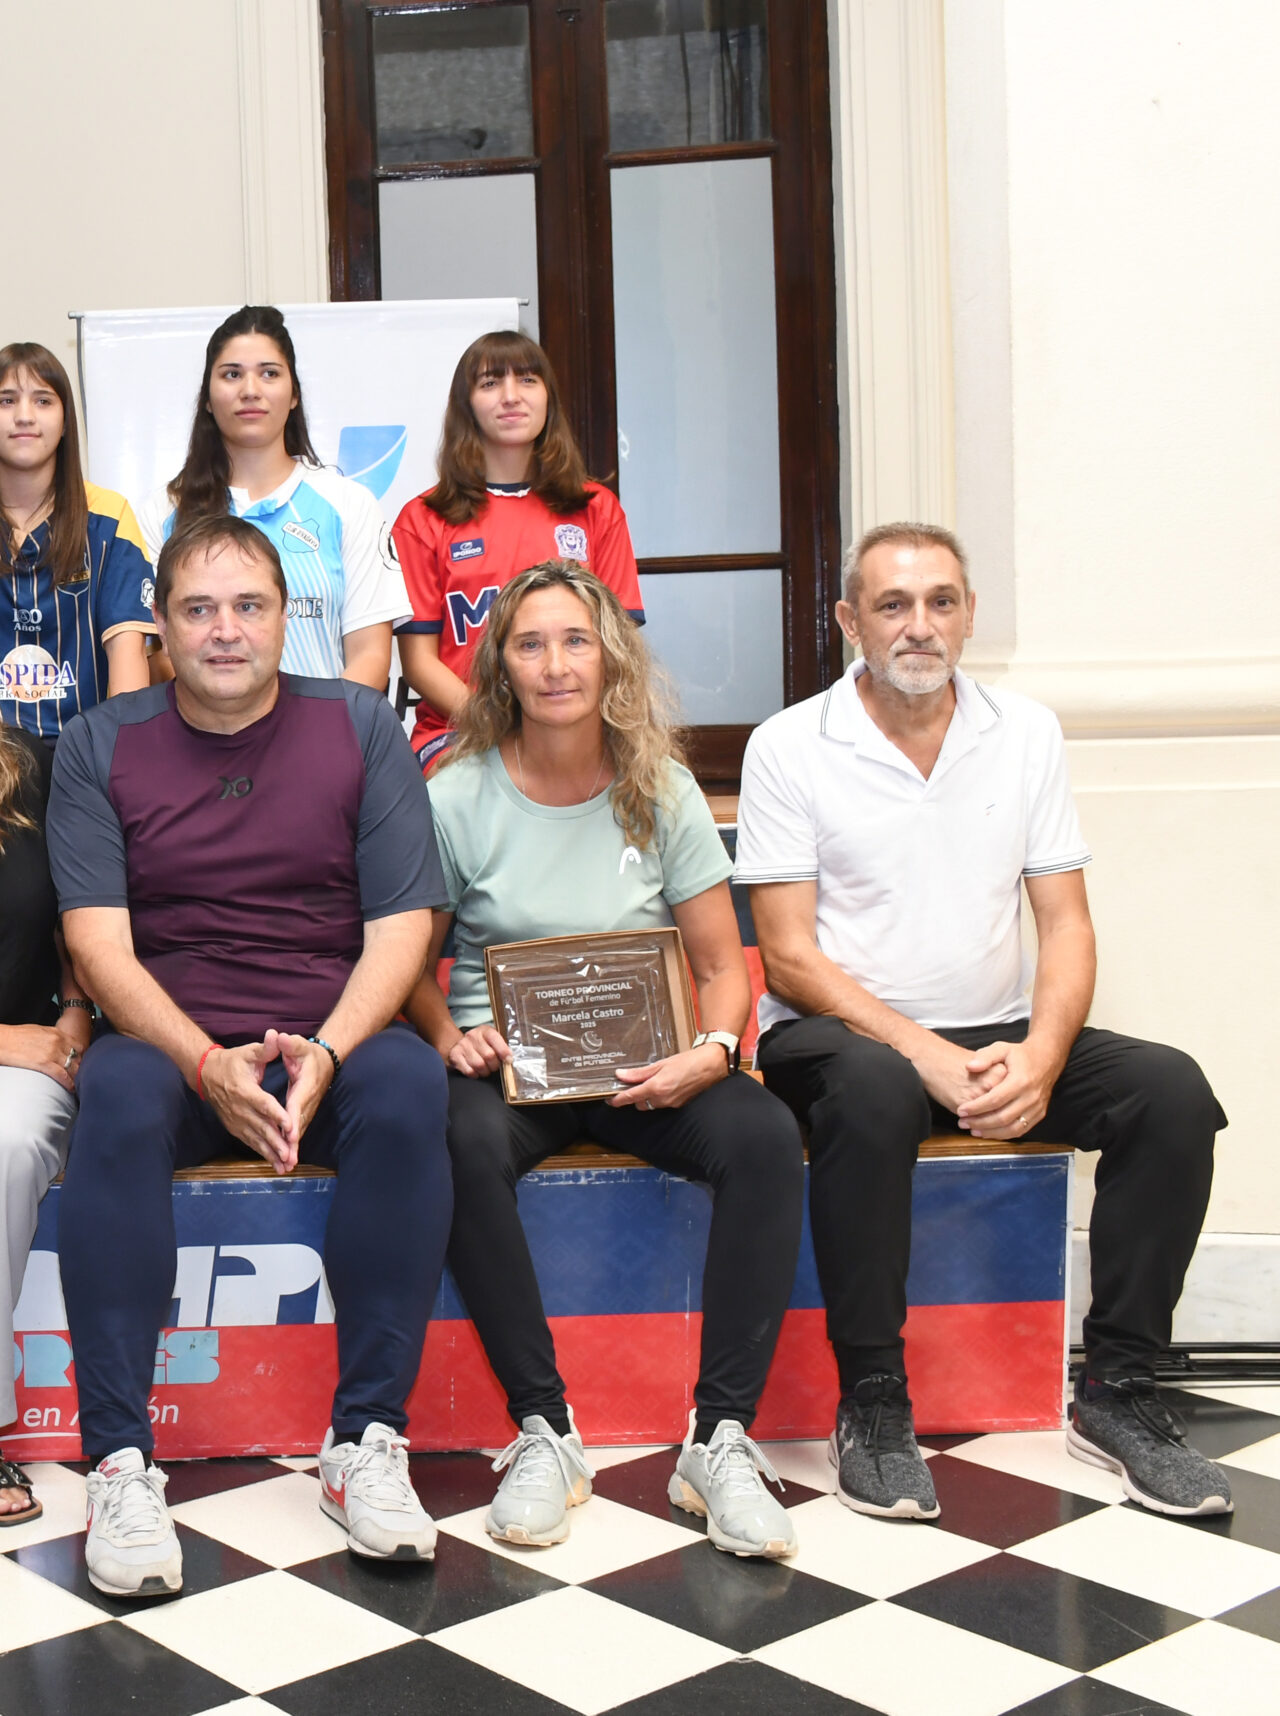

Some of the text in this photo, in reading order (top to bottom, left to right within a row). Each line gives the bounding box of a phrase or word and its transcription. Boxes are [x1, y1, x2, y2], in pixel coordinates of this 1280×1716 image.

[12, 608, 43, 623] 100
[13, 621, 42, 632] Años
[25, 688, 67, 698] SOCIAL
[535, 982, 632, 999] TORNEO PROVINCIAL
[549, 999, 559, 1007] de
[585, 992, 621, 1003] Femenino
[551, 1008, 624, 1023] Marcela Castro
[580, 1021, 596, 1029] 2025
[23, 1407, 60, 1427] en
